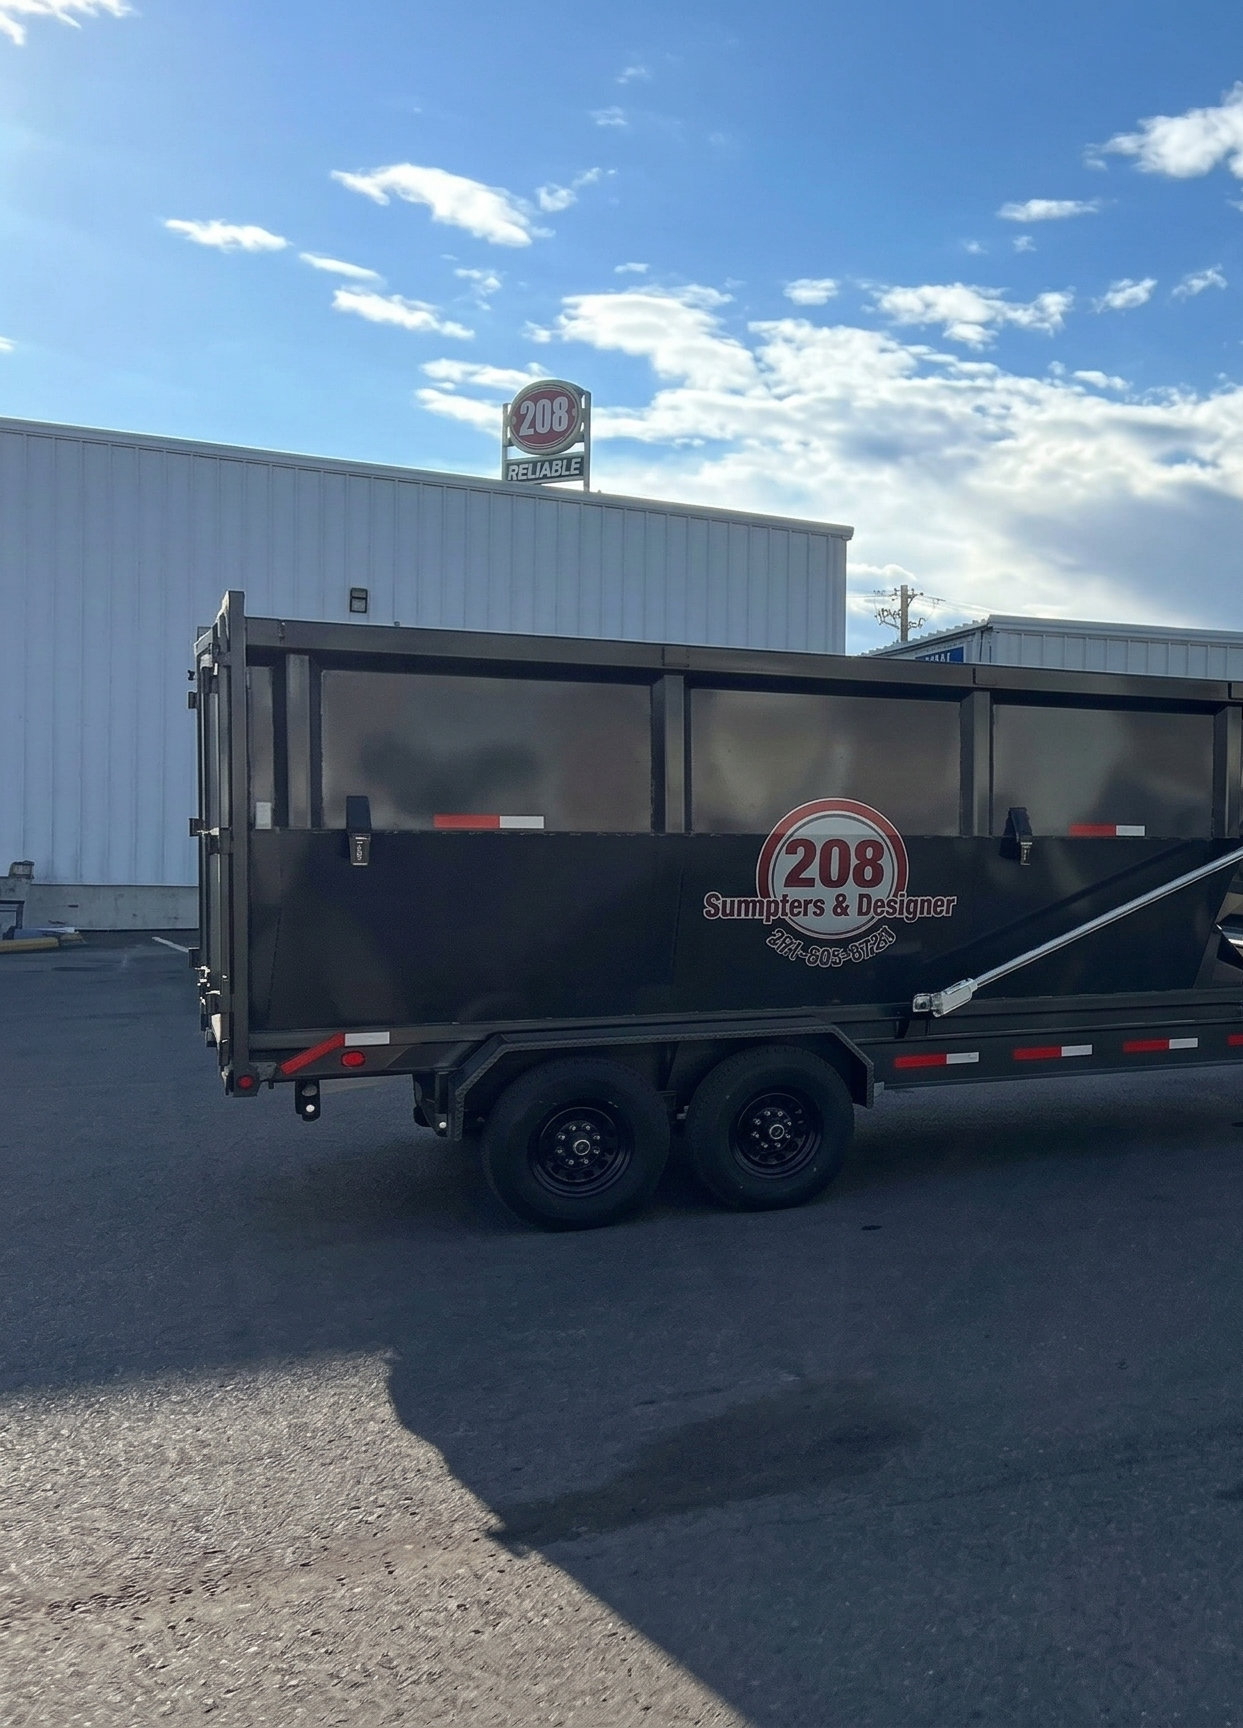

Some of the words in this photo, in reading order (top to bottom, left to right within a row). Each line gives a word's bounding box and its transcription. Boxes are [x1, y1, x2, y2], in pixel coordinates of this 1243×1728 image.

[519, 396, 569, 436] 208
[507, 458, 581, 481] RELIABLE
[783, 838, 885, 888] 208
[832, 893, 850, 917] &
[857, 892, 957, 922] Designer
